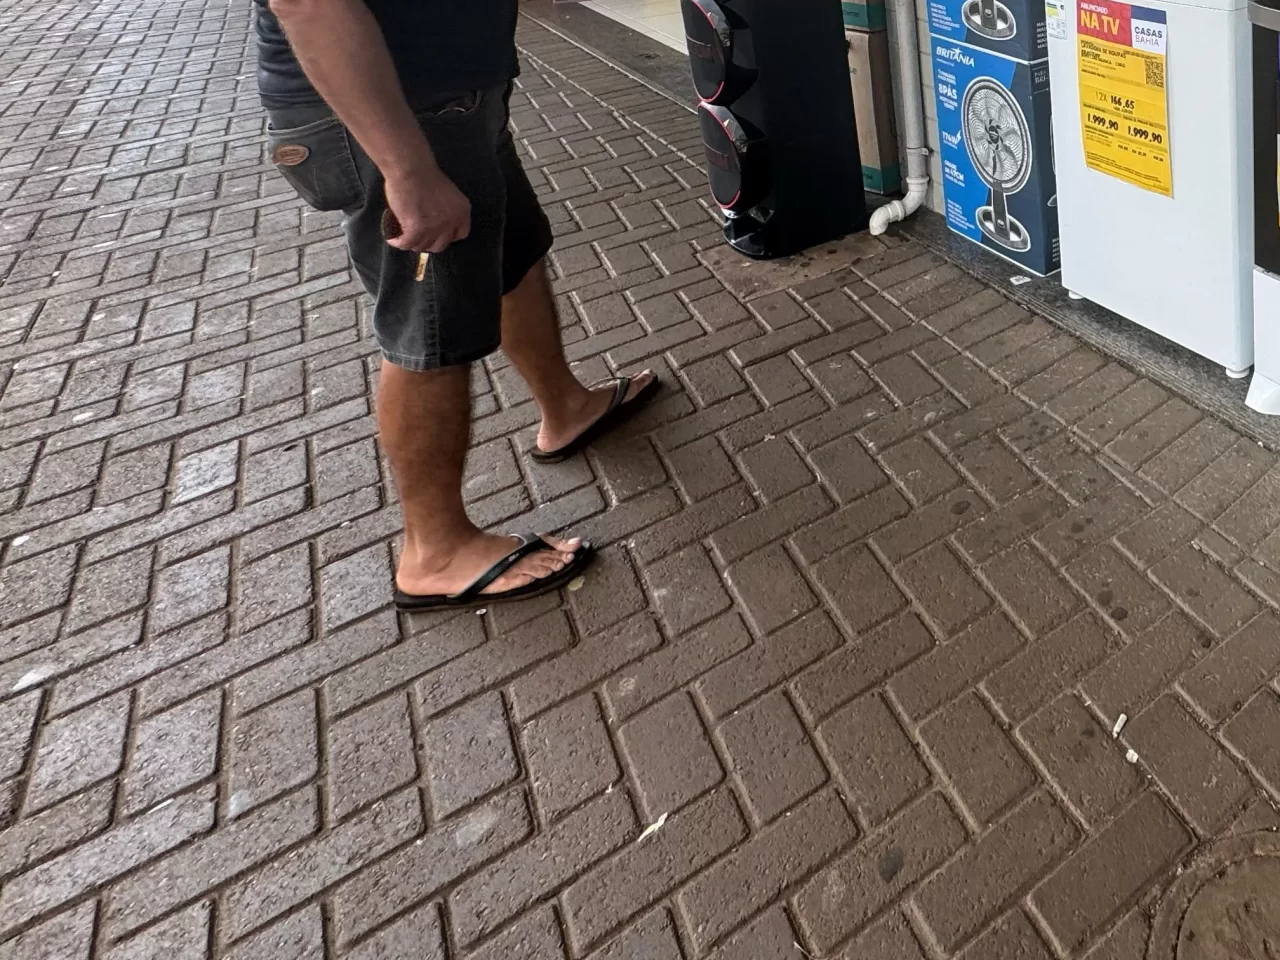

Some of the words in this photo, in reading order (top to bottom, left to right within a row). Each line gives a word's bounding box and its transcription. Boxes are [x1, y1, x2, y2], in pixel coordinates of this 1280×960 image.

[1080, 11, 1099, 29] NA
[1102, 16, 1120, 36] TV
[1134, 26, 1163, 39] CASAS
[1135, 35, 1160, 47] BAHIA
